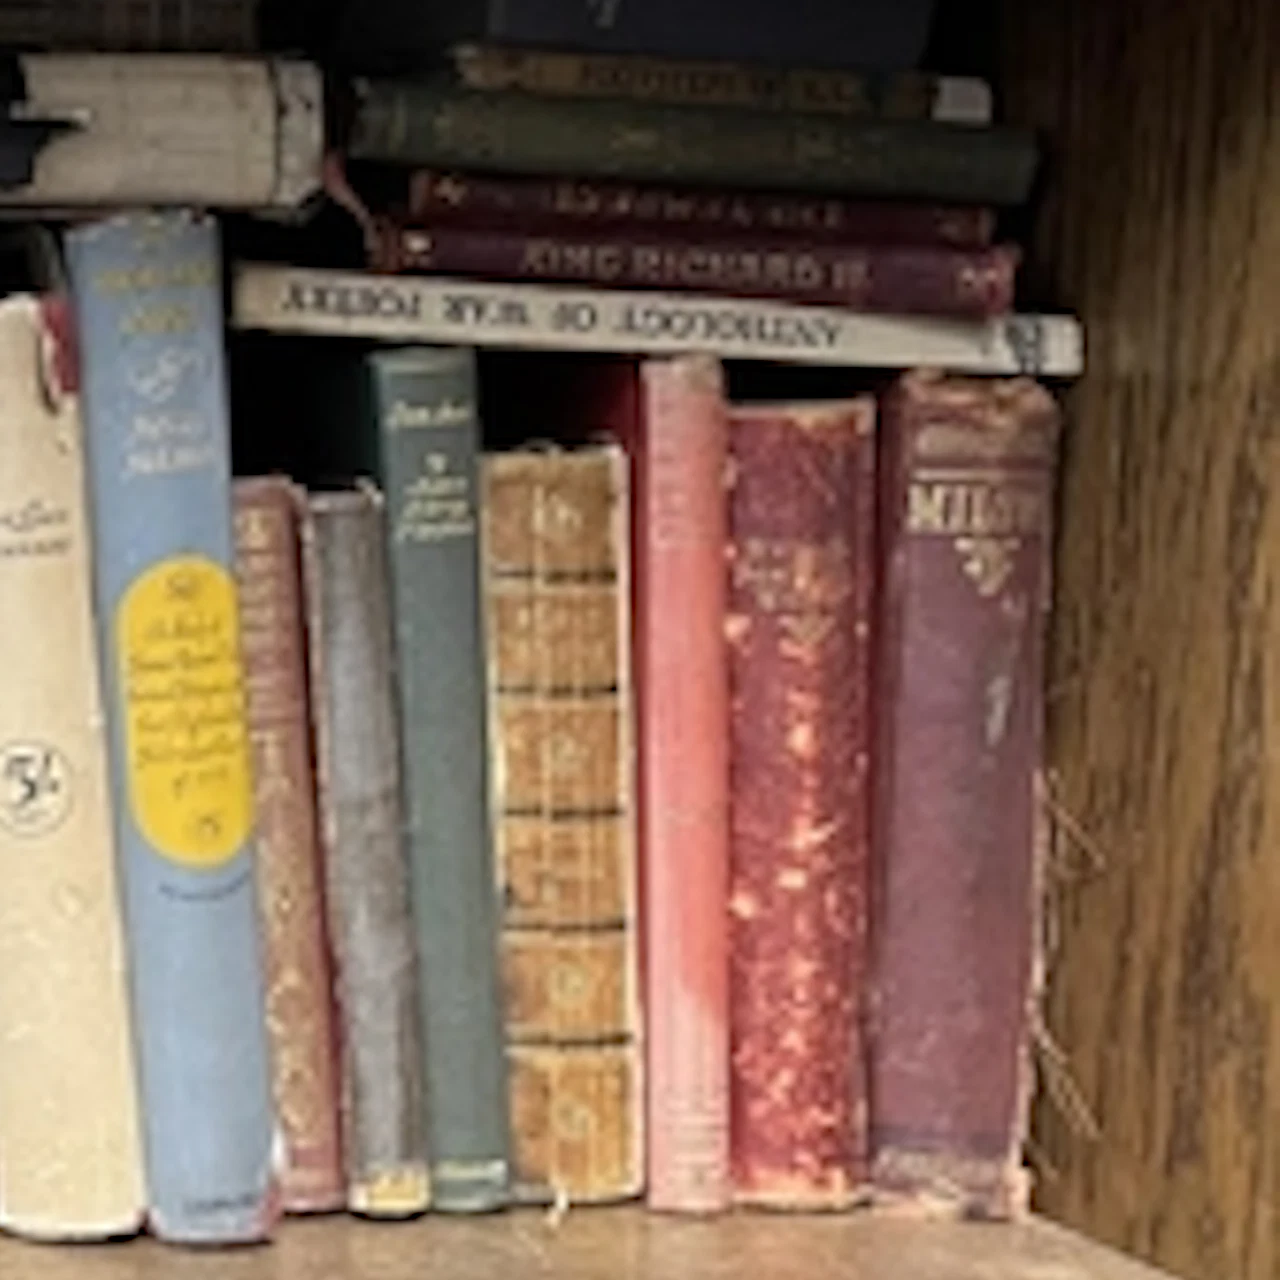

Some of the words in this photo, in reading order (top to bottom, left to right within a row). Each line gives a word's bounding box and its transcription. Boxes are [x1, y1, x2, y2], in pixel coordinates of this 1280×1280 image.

[519, 241, 621, 276] KING
[632, 247, 818, 289] RICHARD
[280, 280, 424, 322] POETRY
[443, 290, 530, 326] WAR
[550, 296, 598, 331] OF
[614, 298, 842, 349] ANTHOLOGY
